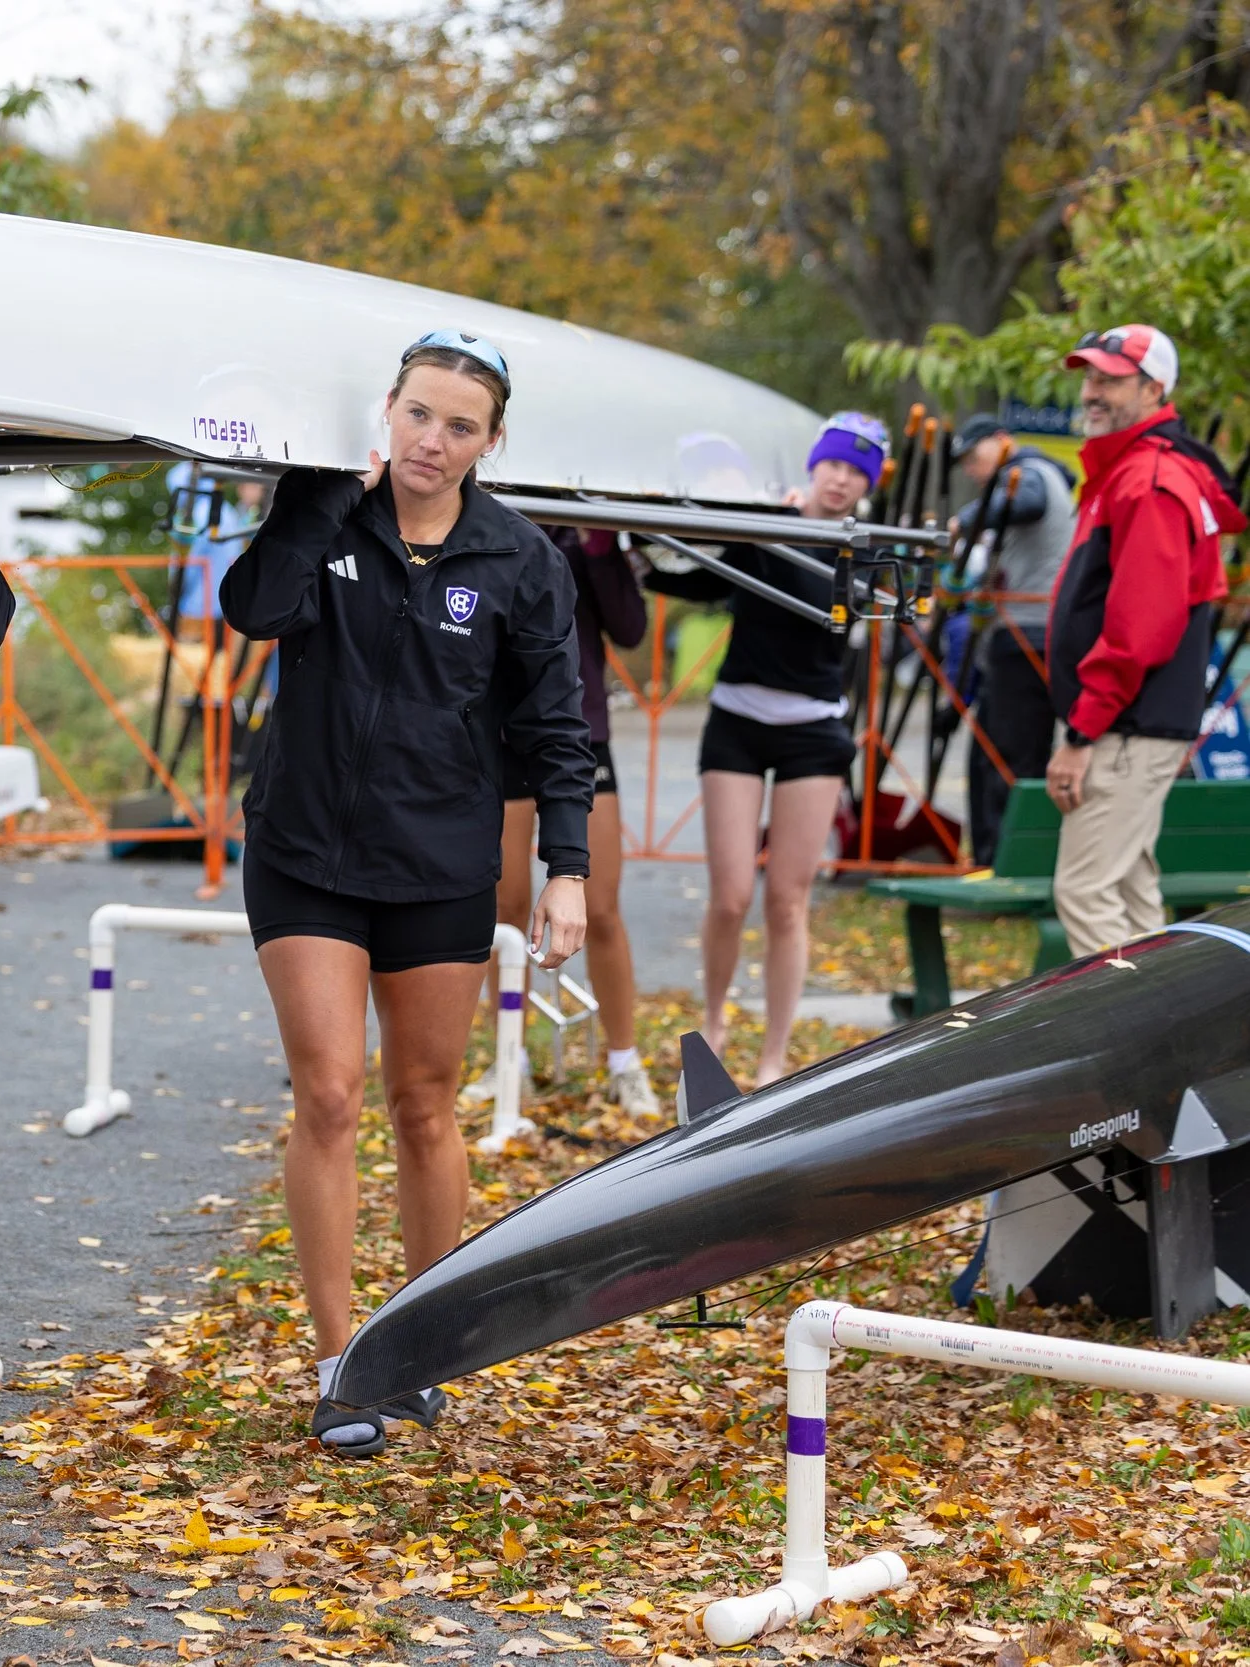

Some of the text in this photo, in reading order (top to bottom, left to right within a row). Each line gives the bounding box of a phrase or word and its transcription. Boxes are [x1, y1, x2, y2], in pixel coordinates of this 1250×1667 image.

[193, 417, 257, 444] VESPOLI
[440, 621, 472, 636] ROWING
[1070, 1109, 1140, 1149] Fluidesign
